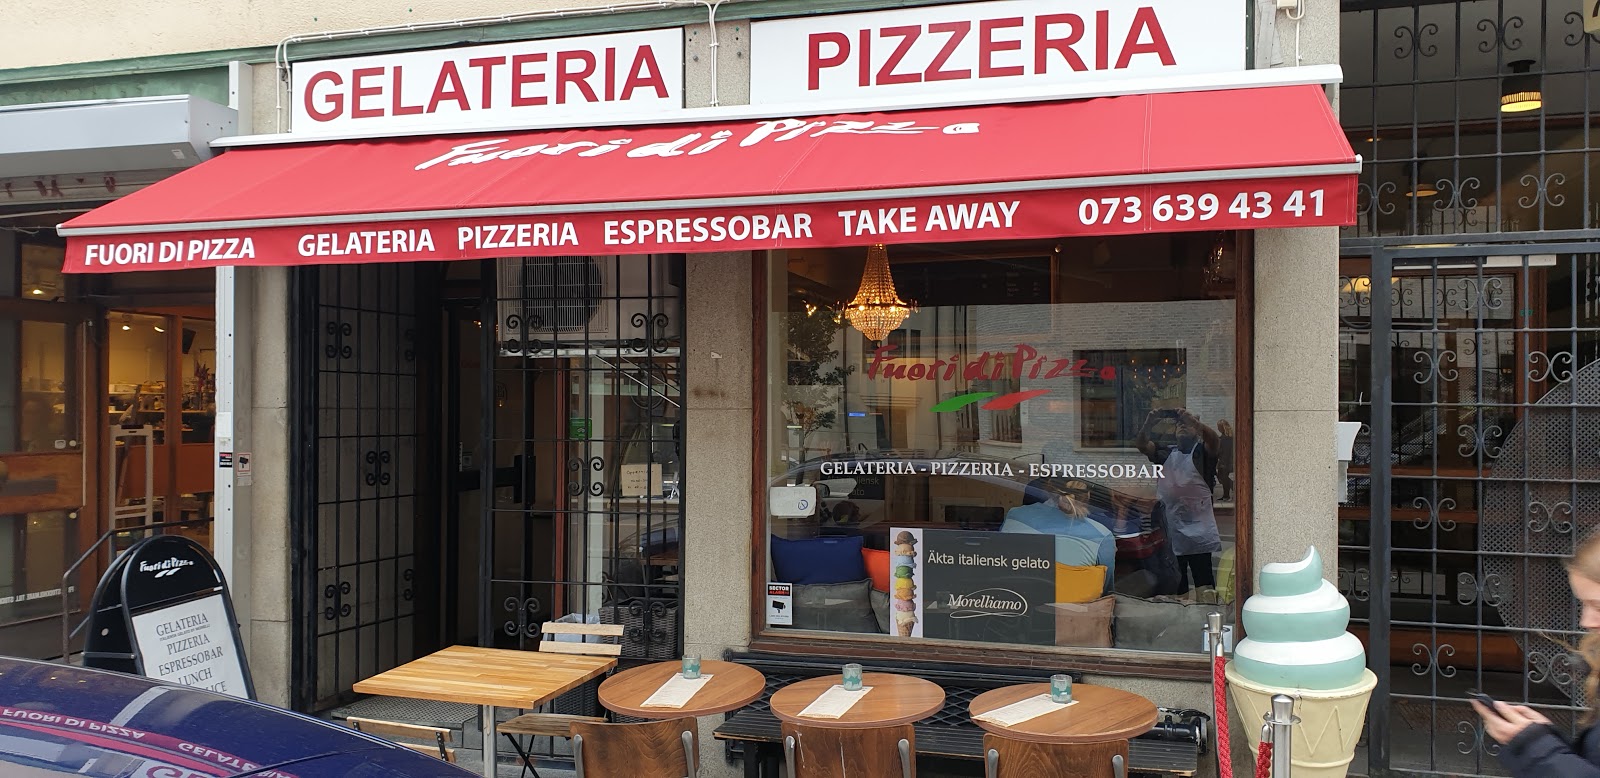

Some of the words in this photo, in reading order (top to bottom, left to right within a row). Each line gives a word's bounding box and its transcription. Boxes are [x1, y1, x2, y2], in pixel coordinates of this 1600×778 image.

[808, 7, 1177, 91] PIZZERIA
[304, 44, 668, 122] GELATERIA
[415, 139, 632, 171] Fuori
[627, 130, 732, 157] di
[739, 119, 980, 147] Pizza
[838, 206, 917, 237] TAKE
[925, 201, 1021, 232] AWAY
[1078, 196, 1142, 226] 073
[1152, 193, 1219, 222] 639
[1228, 191, 1273, 219] 43
[1283, 189, 1324, 217] 41
[84, 242, 154, 266] FUORI
[158, 241, 184, 263] DI
[186, 237, 256, 261] PIZZA
[297, 229, 436, 257] GELATERIA
[457, 220, 580, 251] PIZZERIA
[603, 213, 813, 245] ESPRESSOBAR
[868, 344, 959, 381] Fuori
[963, 351, 1006, 381] di
[1012, 343, 1117, 380] Pizza
[820, 461, 917, 475] GELATERIA
[930, 462, 1014, 477] PIZZERIA
[1029, 463, 1165, 480] ESPRESSOBAR
[927, 550, 954, 564] Äkta
[958, 553, 1008, 567] italiensk
[1011, 556, 1050, 570] gelato
[947, 593, 1022, 611] Morelliamo
[156, 613, 209, 637] GELATERIA
[166, 633, 211, 656] PIZZERIA
[158, 646, 224, 677] ESPRESSOBAR
